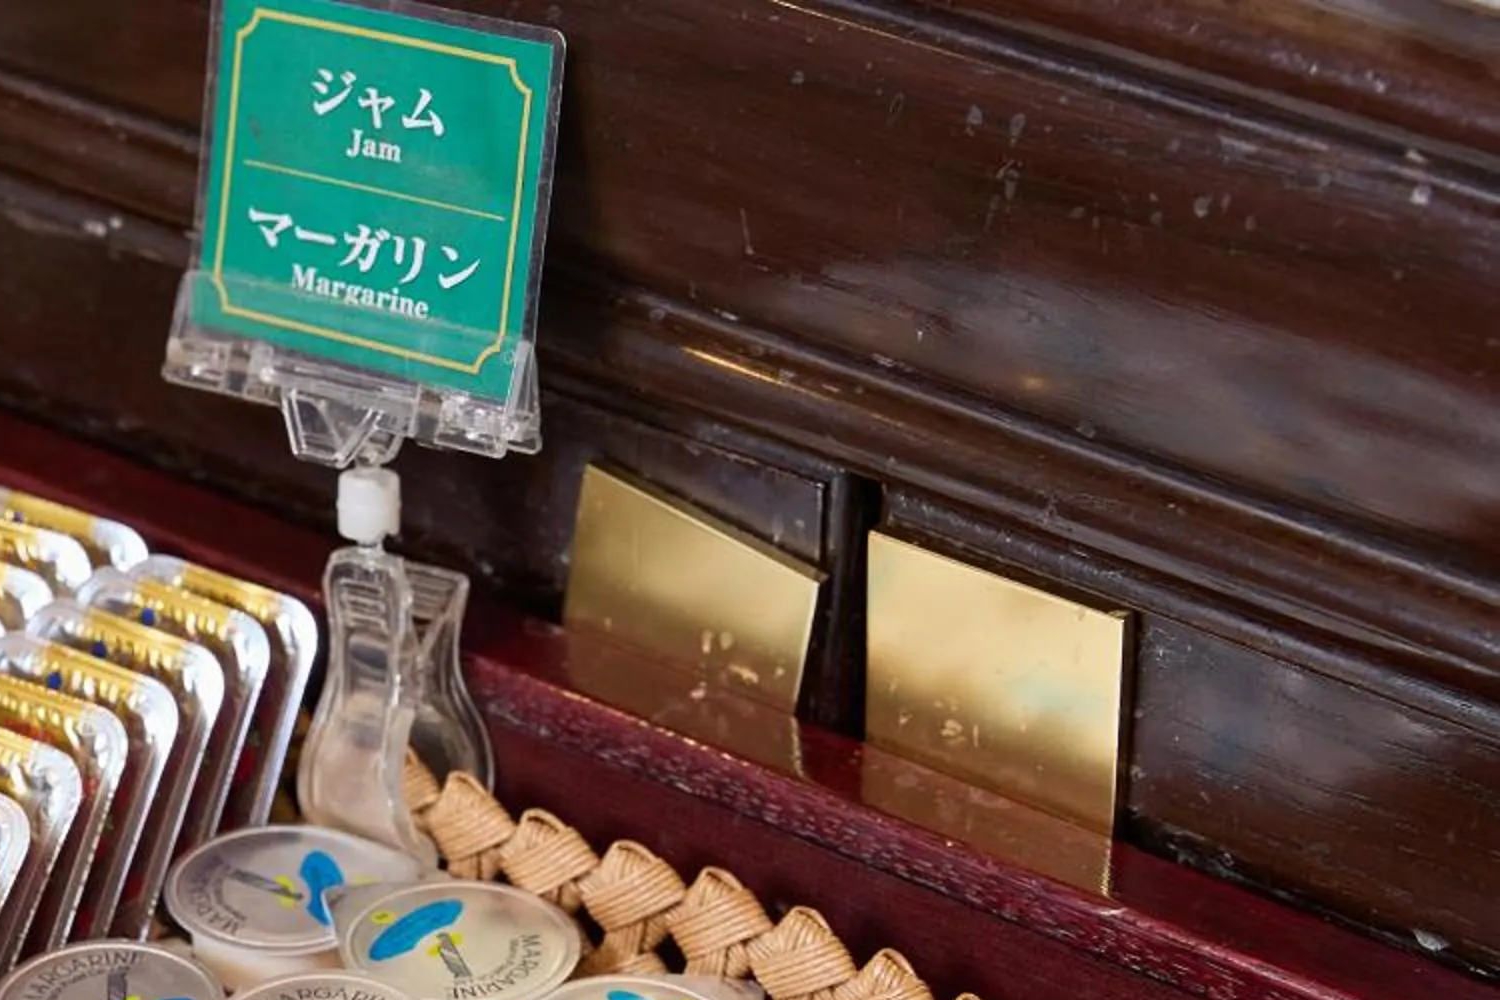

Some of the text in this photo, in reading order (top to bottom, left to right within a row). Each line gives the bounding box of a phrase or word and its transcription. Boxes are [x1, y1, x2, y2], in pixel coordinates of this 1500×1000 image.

[311, 67, 445, 137] ジャム
[346, 129, 401, 162] Jam
[248, 206, 481, 290] マーガリン
[290, 264, 429, 320] Margarine
